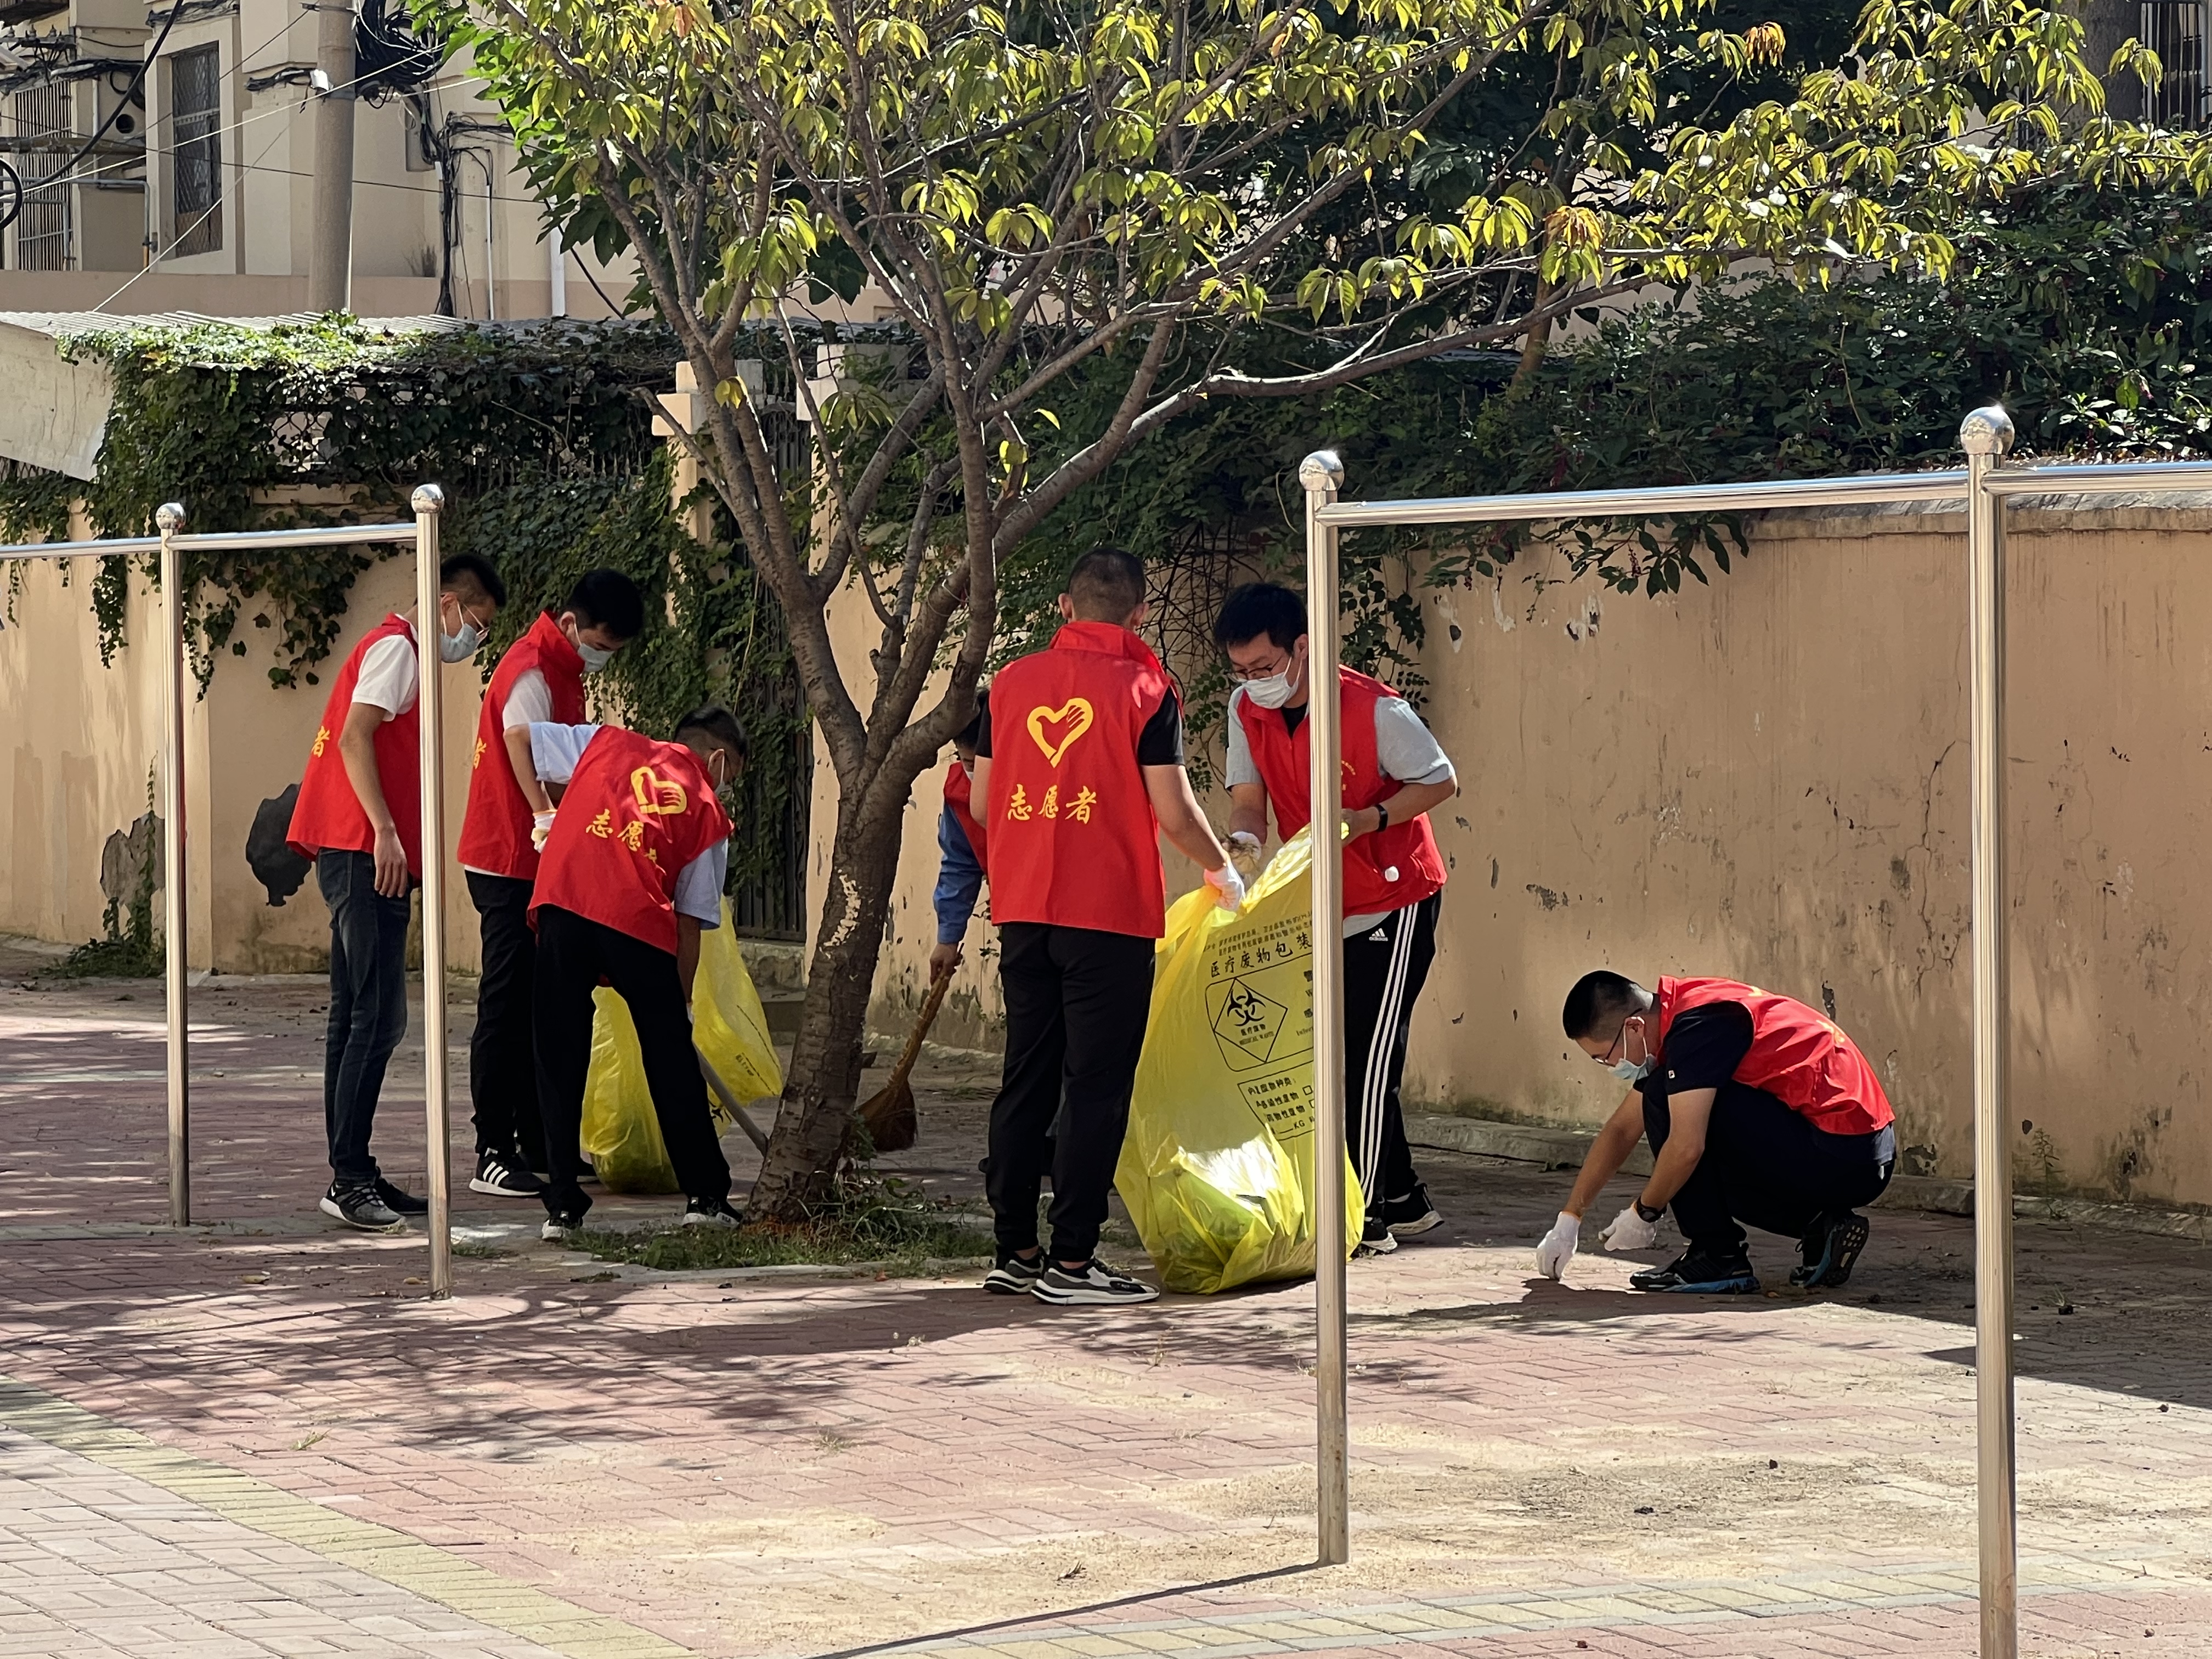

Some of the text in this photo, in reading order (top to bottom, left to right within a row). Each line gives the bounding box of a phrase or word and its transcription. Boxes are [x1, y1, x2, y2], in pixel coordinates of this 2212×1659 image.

[1007, 783, 1097, 824] 志愿者
[1210, 932, 1312, 978] 医疗废物包装
[1294, 1120, 1305, 1129] KG
